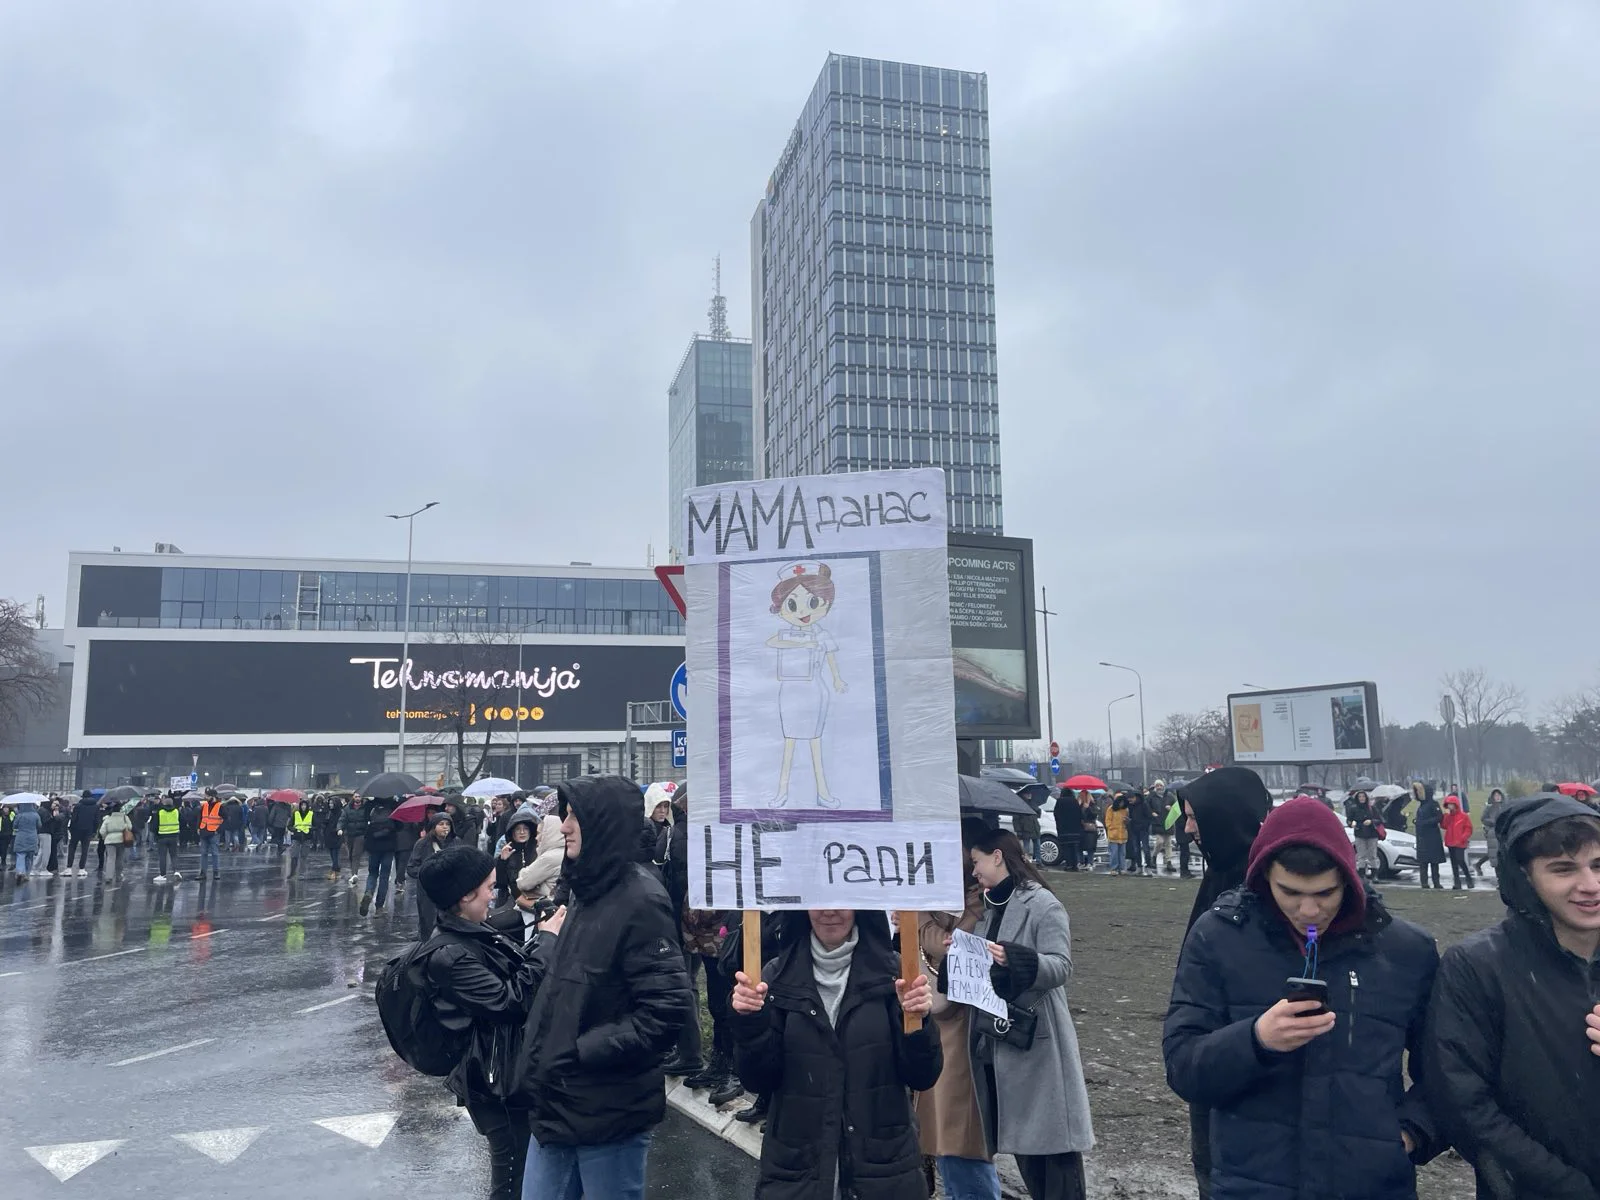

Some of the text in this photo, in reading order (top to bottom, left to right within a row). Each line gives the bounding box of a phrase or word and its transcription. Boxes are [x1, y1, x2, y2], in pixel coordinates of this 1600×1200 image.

[687, 484, 931, 556] МАМА данас
[948, 557, 1016, 571] PCOMING ACTS
[704, 822, 935, 909] НЕ ради
